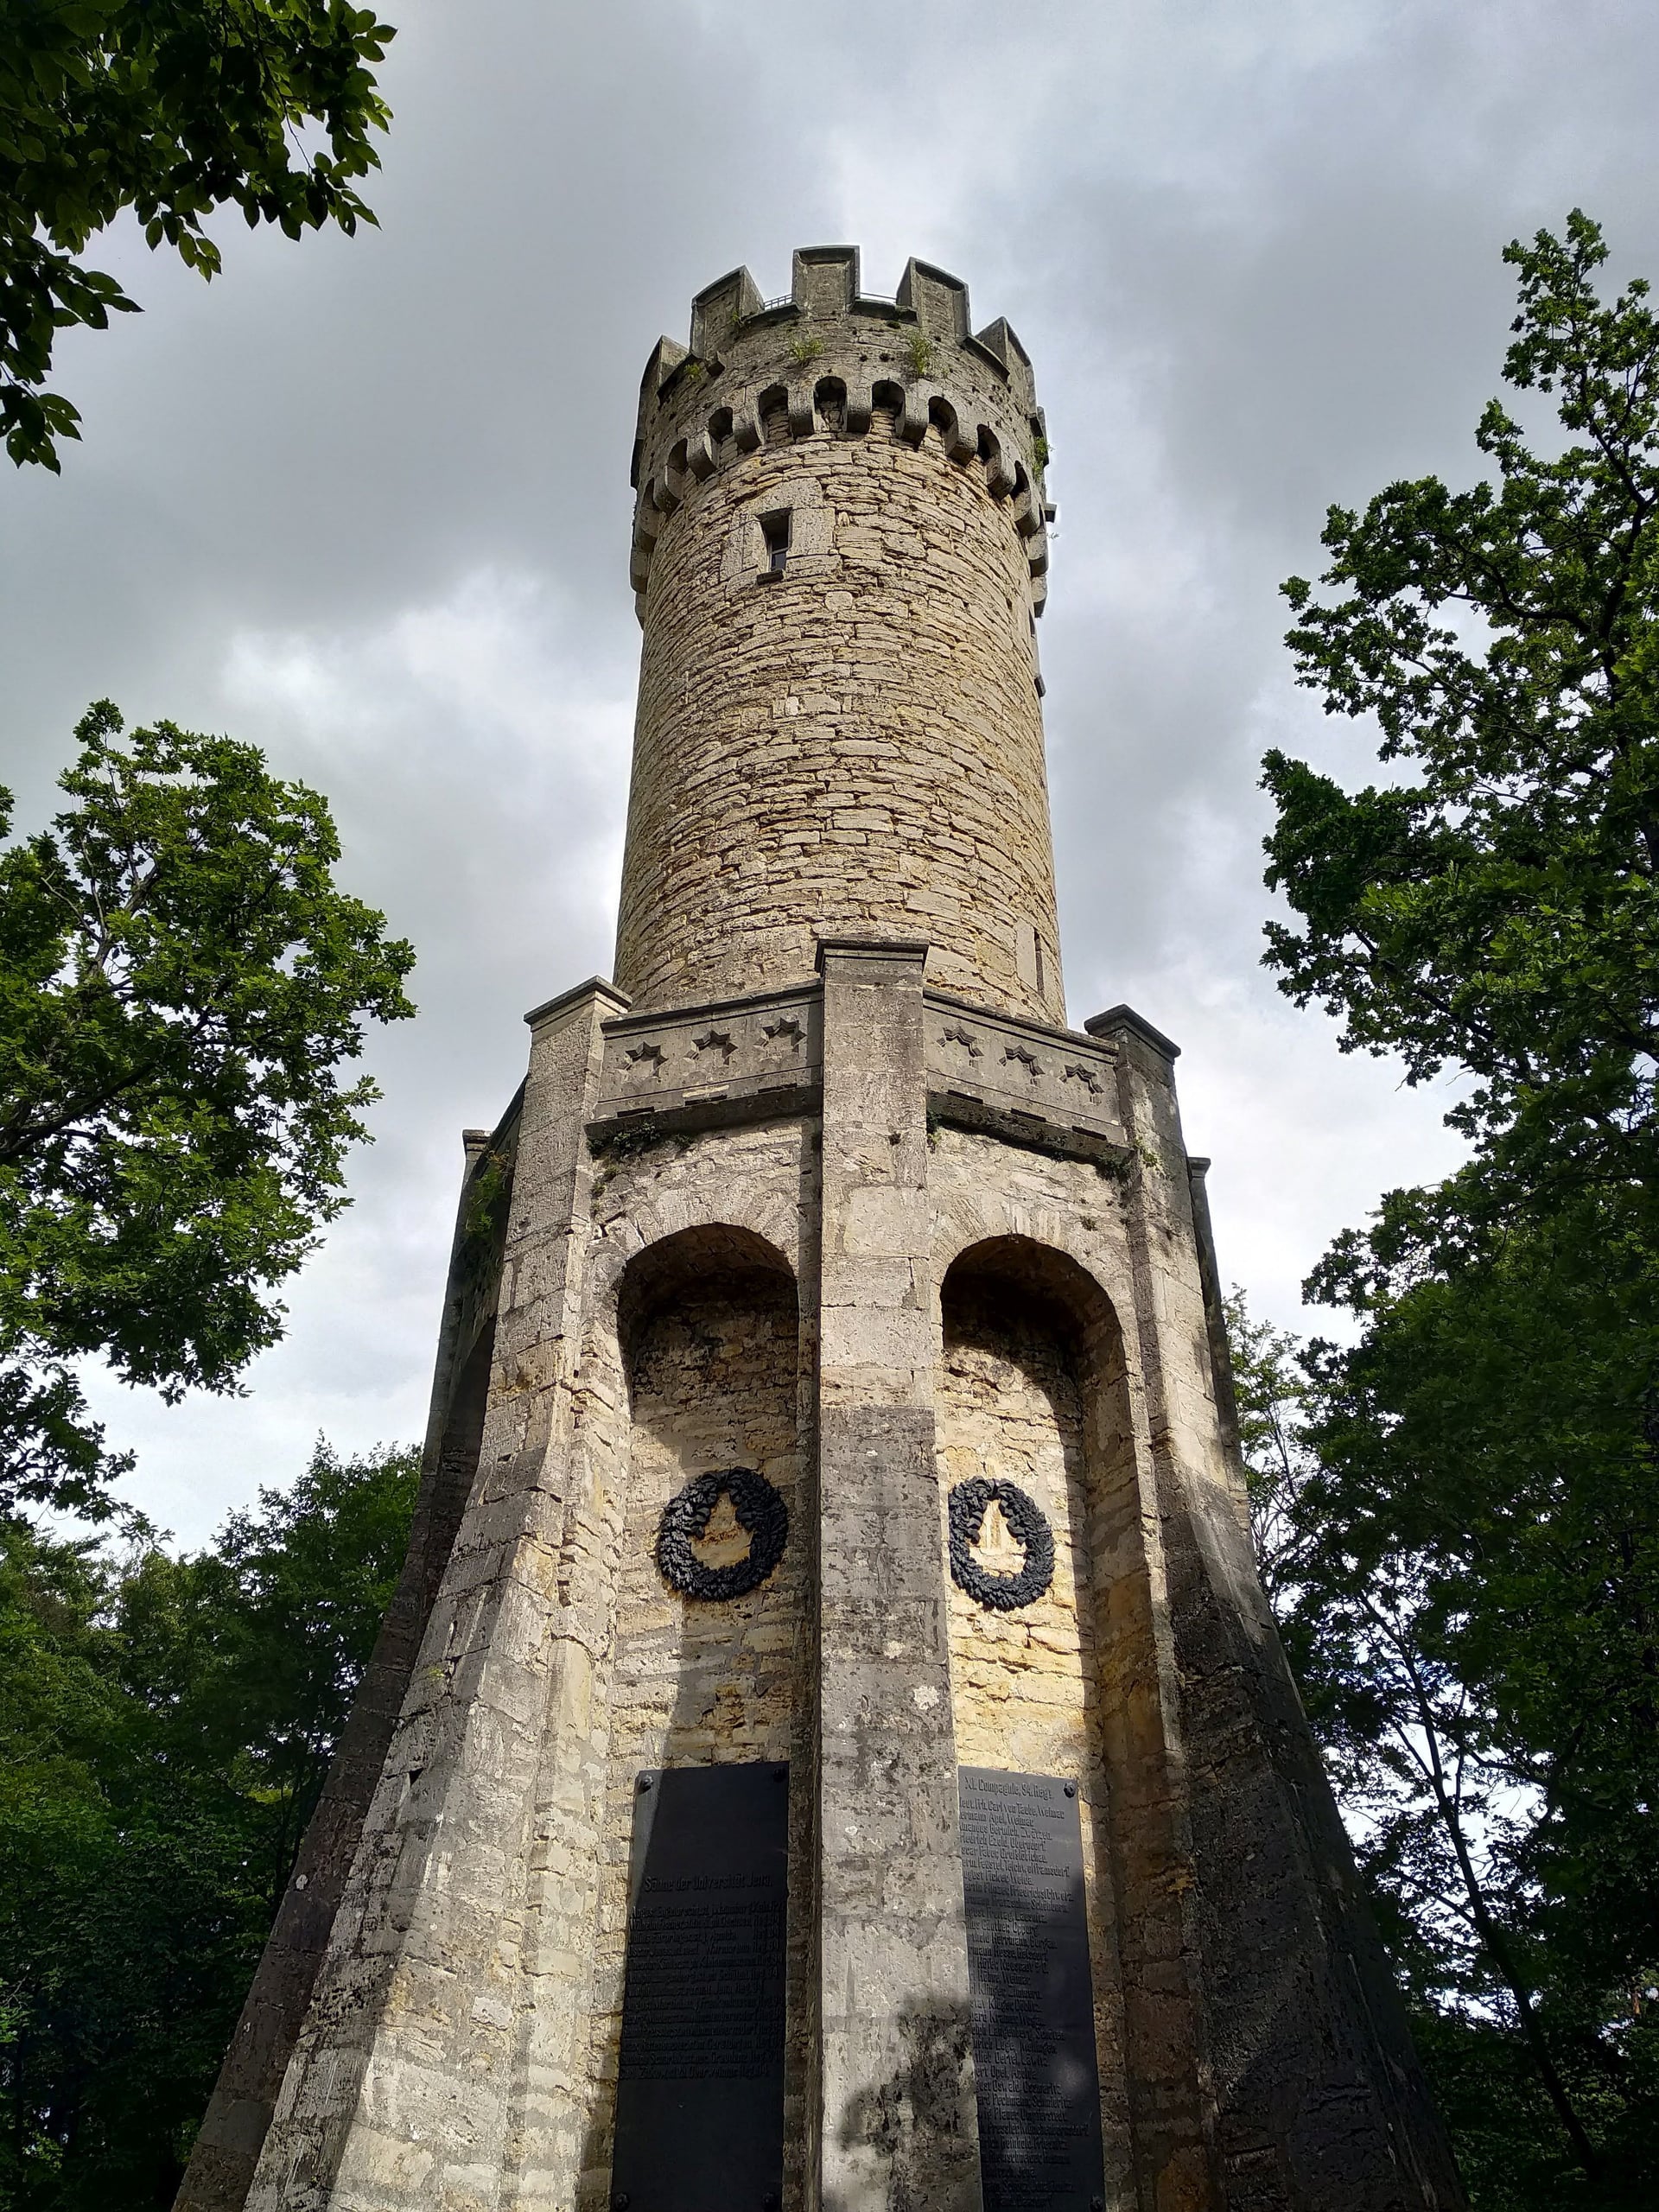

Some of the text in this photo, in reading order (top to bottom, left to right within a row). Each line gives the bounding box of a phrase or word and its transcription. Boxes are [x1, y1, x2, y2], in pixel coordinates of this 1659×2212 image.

[959, 1808, 985, 1821] ermann
[959, 1831, 988, 1846] riedrich
[961, 1844, 976, 1856] scar
[962, 1855, 977, 1869] erm.
[963, 1867, 982, 1883] ugust
